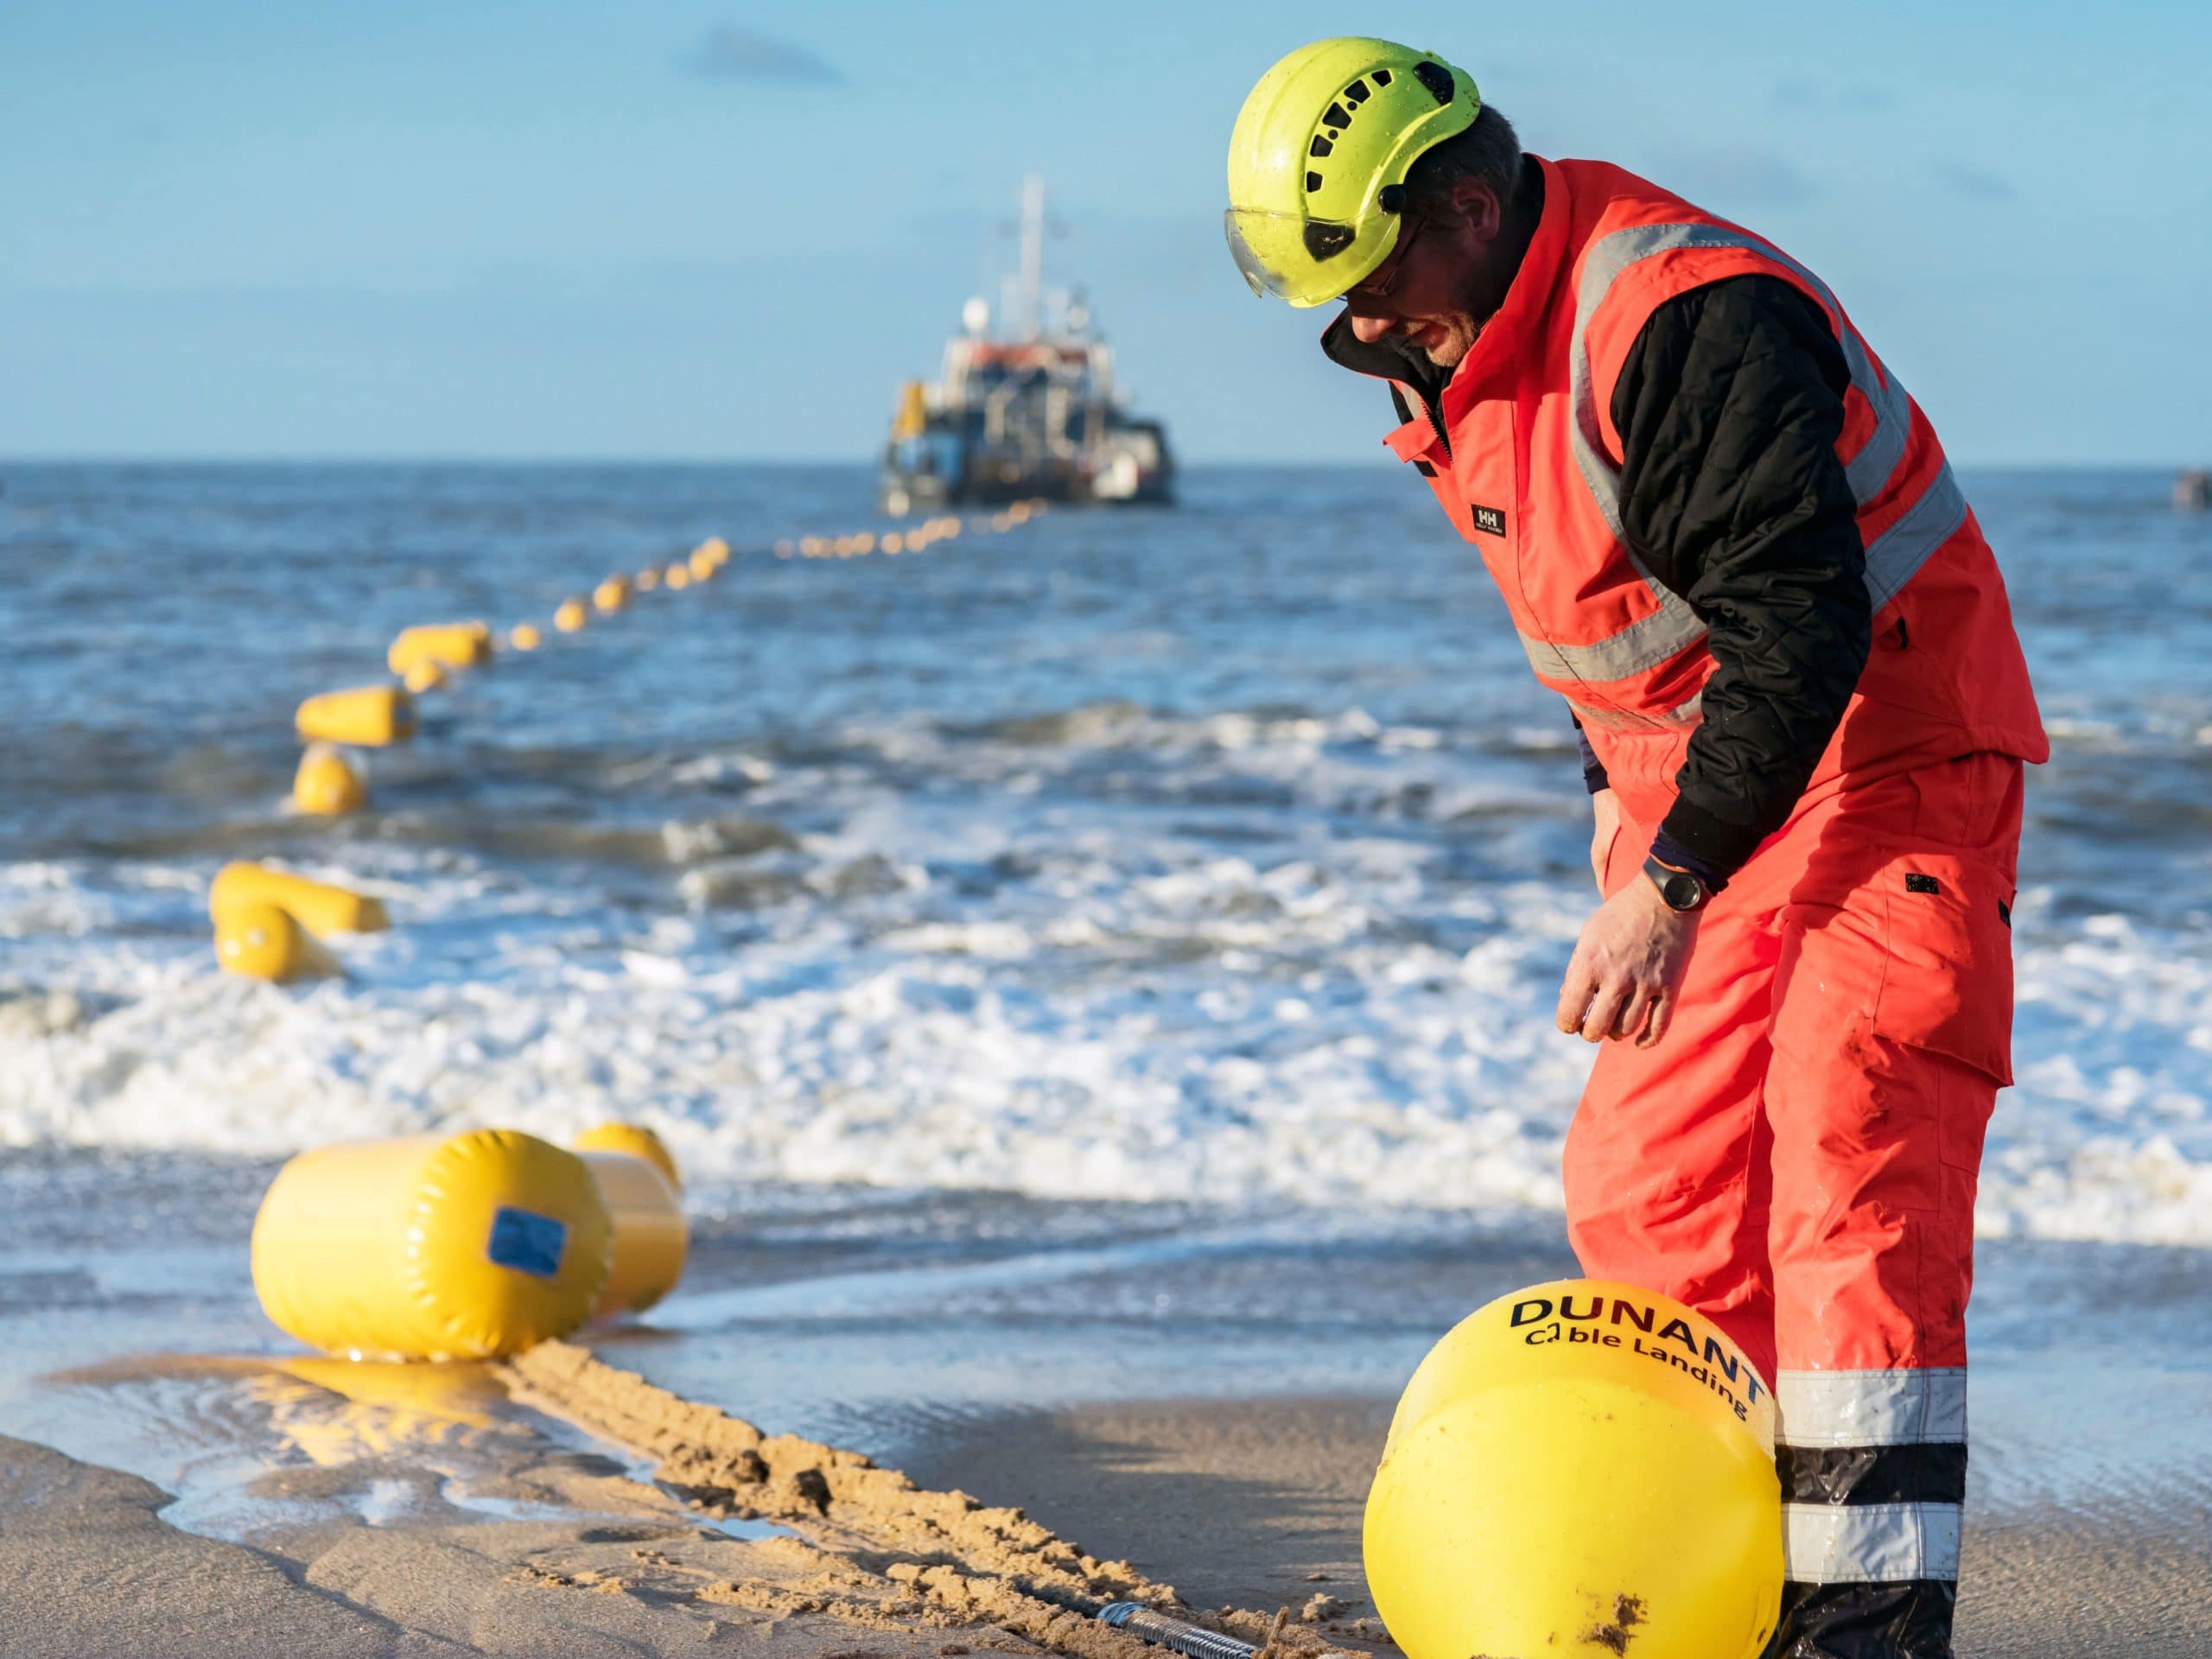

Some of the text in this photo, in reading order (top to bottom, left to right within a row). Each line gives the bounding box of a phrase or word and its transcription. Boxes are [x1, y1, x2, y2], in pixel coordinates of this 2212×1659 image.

[1478, 510, 1497, 527] HH
[1510, 1295, 1764, 1405] DUNANT
[1633, 1338, 1748, 1421] Landing
